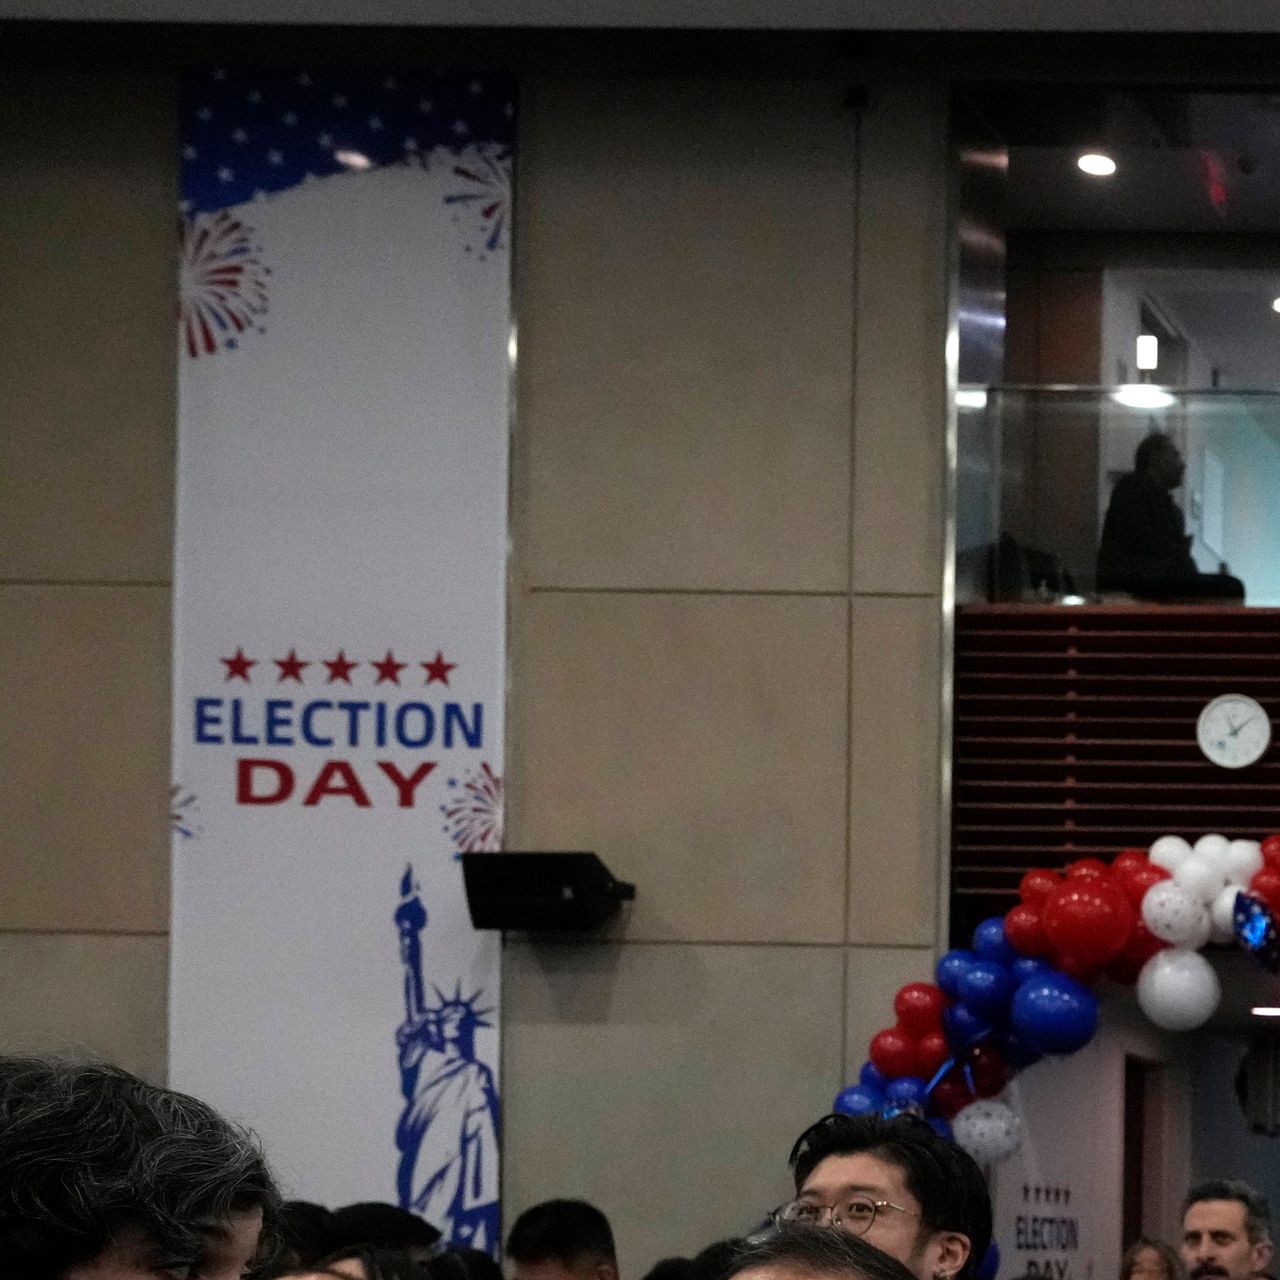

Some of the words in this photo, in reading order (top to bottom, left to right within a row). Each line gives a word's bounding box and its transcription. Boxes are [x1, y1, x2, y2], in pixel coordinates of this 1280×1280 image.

[194, 697, 484, 748] ELECTION
[236, 758, 438, 808] DAY
[1016, 1216, 1079, 1250] ELECTION
